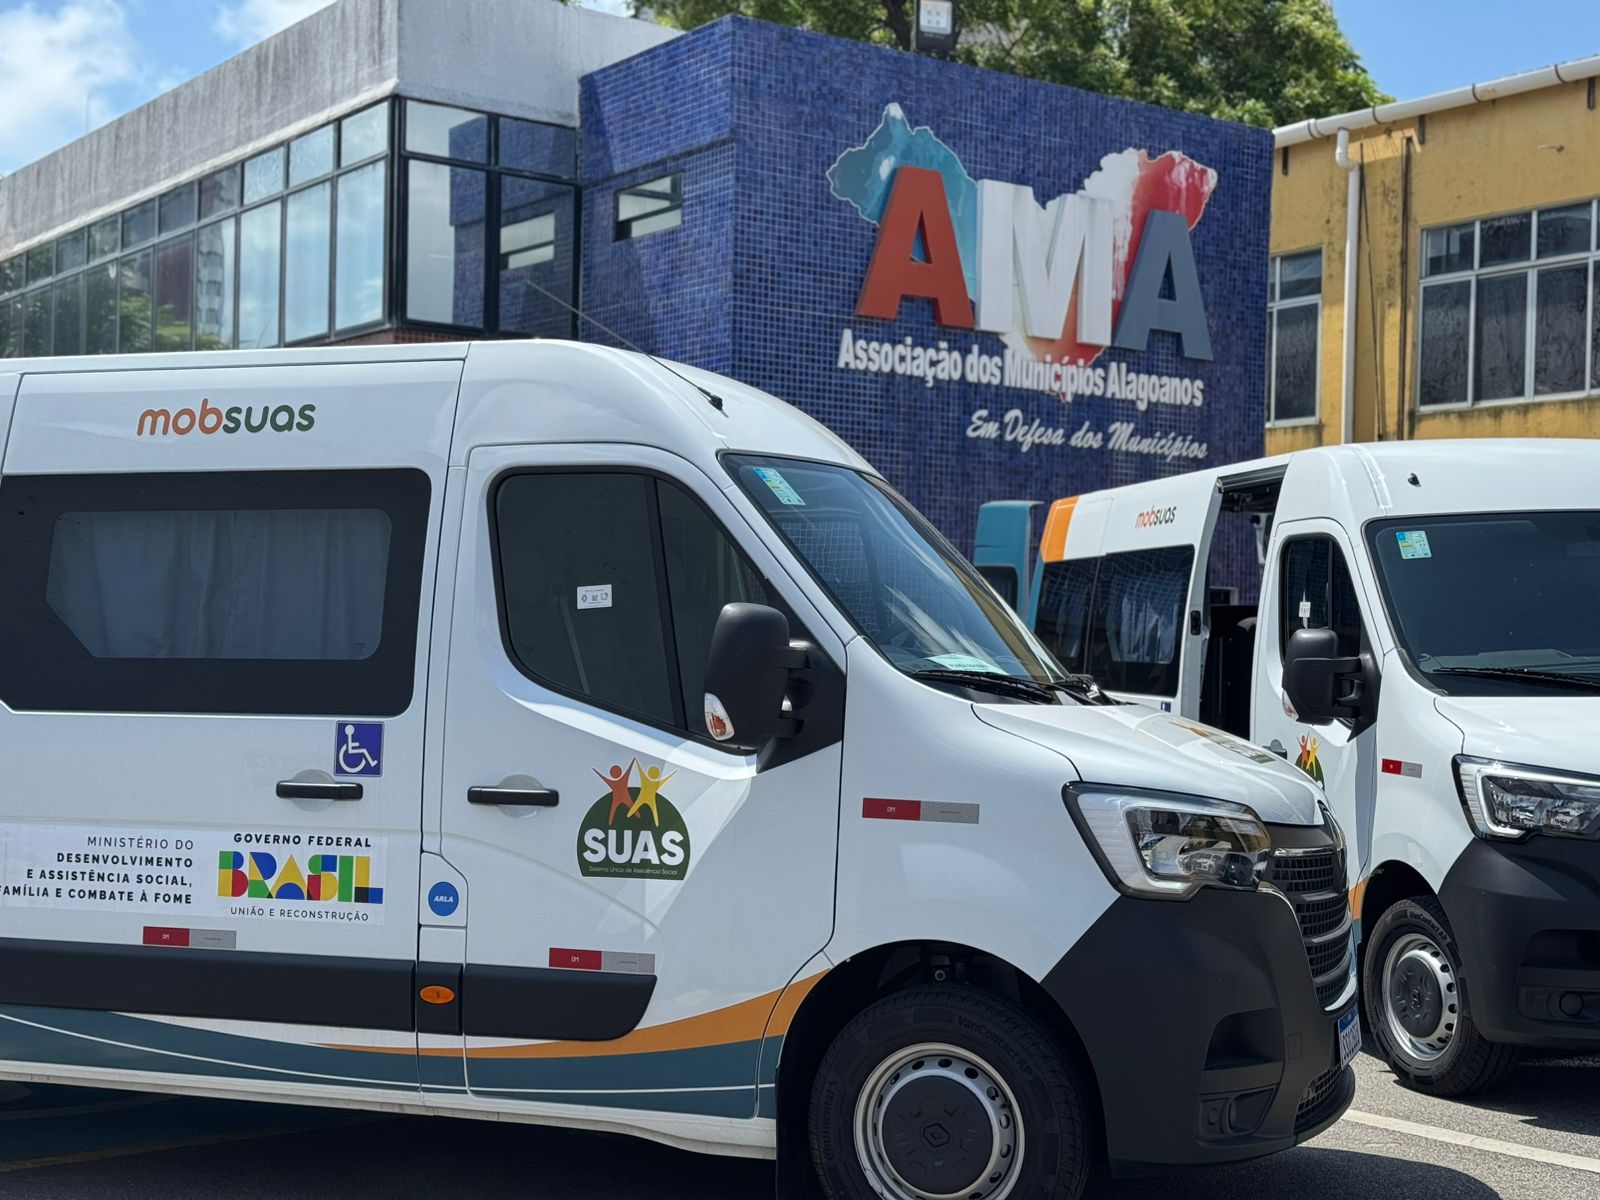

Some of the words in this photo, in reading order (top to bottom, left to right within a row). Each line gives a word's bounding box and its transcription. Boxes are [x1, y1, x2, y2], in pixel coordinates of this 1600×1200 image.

[855, 165, 1213, 361] AMA
[837, 328, 962, 388] Associação
[965, 344, 1002, 386] dos
[1003, 349, 1105, 402] Municípios
[1105, 361, 1204, 411] Alagoanos
[136, 399, 316, 436] mobsuas
[966, 409, 1000, 439] Em
[1004, 408, 1065, 452] Defesa
[1068, 421, 1103, 449] dos
[1108, 421, 1208, 462] Municípios
[1135, 504, 1177, 529] mobsuas
[87, 835, 168, 849] MINISTÉRIO
[175, 839, 194, 850] DO
[233, 833, 301, 845] GOVERNO
[308, 836, 372, 848] FEDERAL
[582, 828, 685, 866] SUAS
[56, 852, 193, 868] DESENVOLVIMENTO
[26, 868, 34, 879] E
[38, 869, 130, 884] ASSISTÊNCIA
[135, 873, 193, 888] SOCIAL,
[217, 850, 384, 904] BRASIL
[0, 884, 50, 898] AMÍLIA
[55, 887, 63, 898] E
[67, 888, 134, 902] COMBATE
[139, 889, 148, 903] À
[154, 892, 193, 904] FOME
[433, 895, 454, 903] ARLA
[230, 905, 264, 917] UNIÃO
[279, 909, 369, 922] RECONSTRUÇÃO
